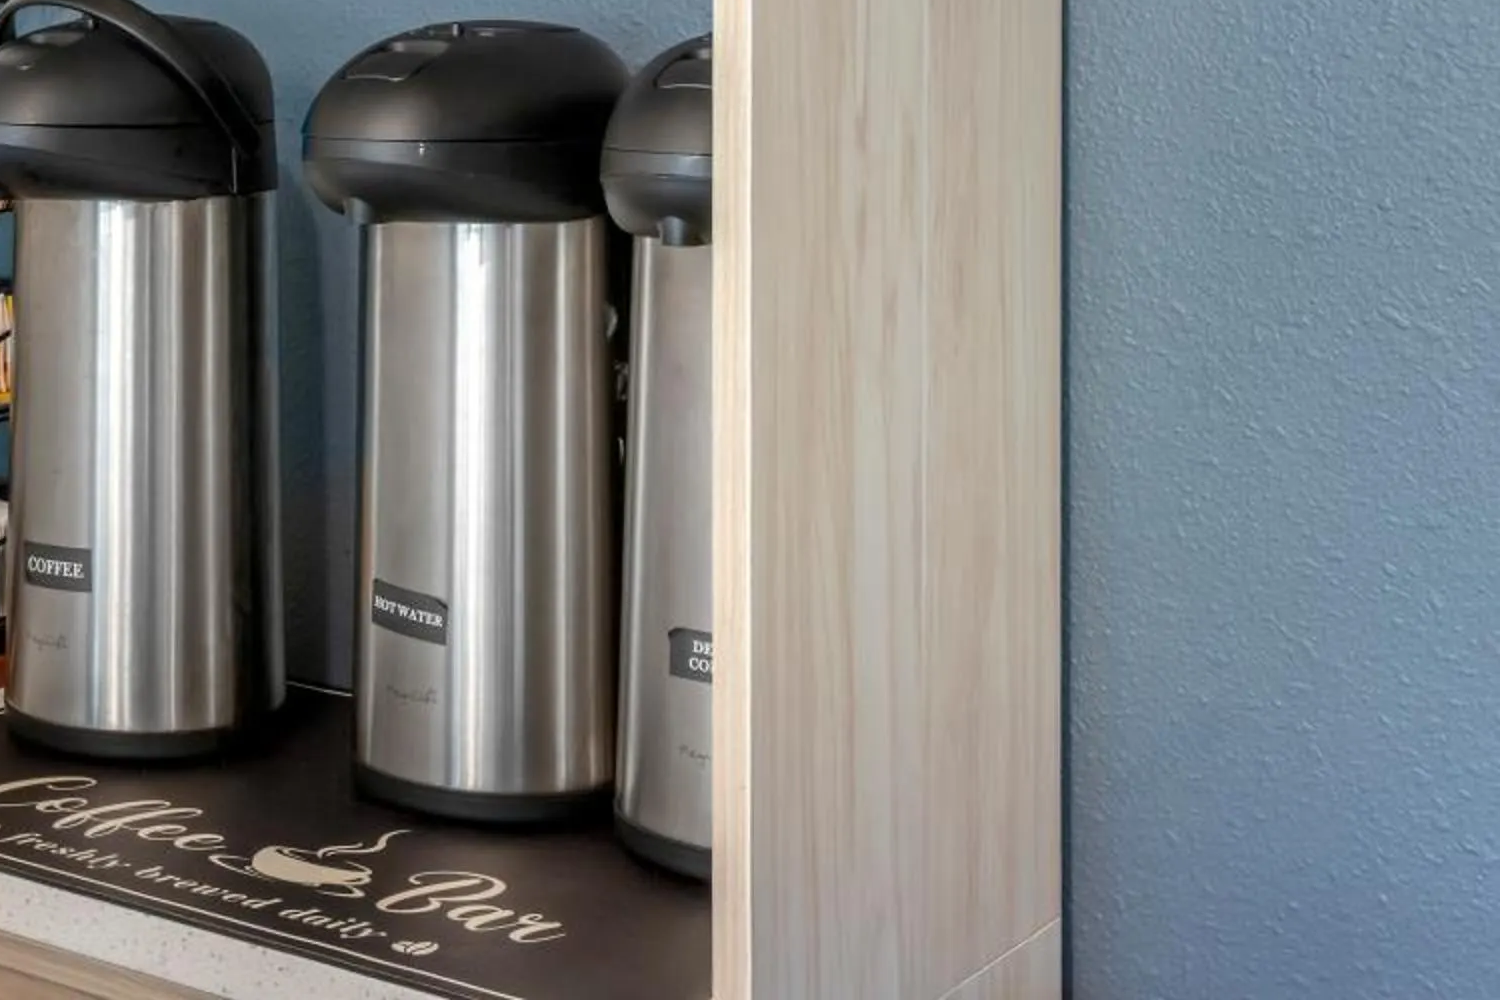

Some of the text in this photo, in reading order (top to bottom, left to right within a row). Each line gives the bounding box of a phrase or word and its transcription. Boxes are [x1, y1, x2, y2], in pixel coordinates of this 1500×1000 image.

[27, 554, 85, 579] COFFEE
[374, 595, 444, 628] HOT WATER
[688, 657, 712, 674] CO
[134, 864, 283, 910] brewed
[278, 905, 388, 940] daily
[375, 870, 567, 943] Bar
